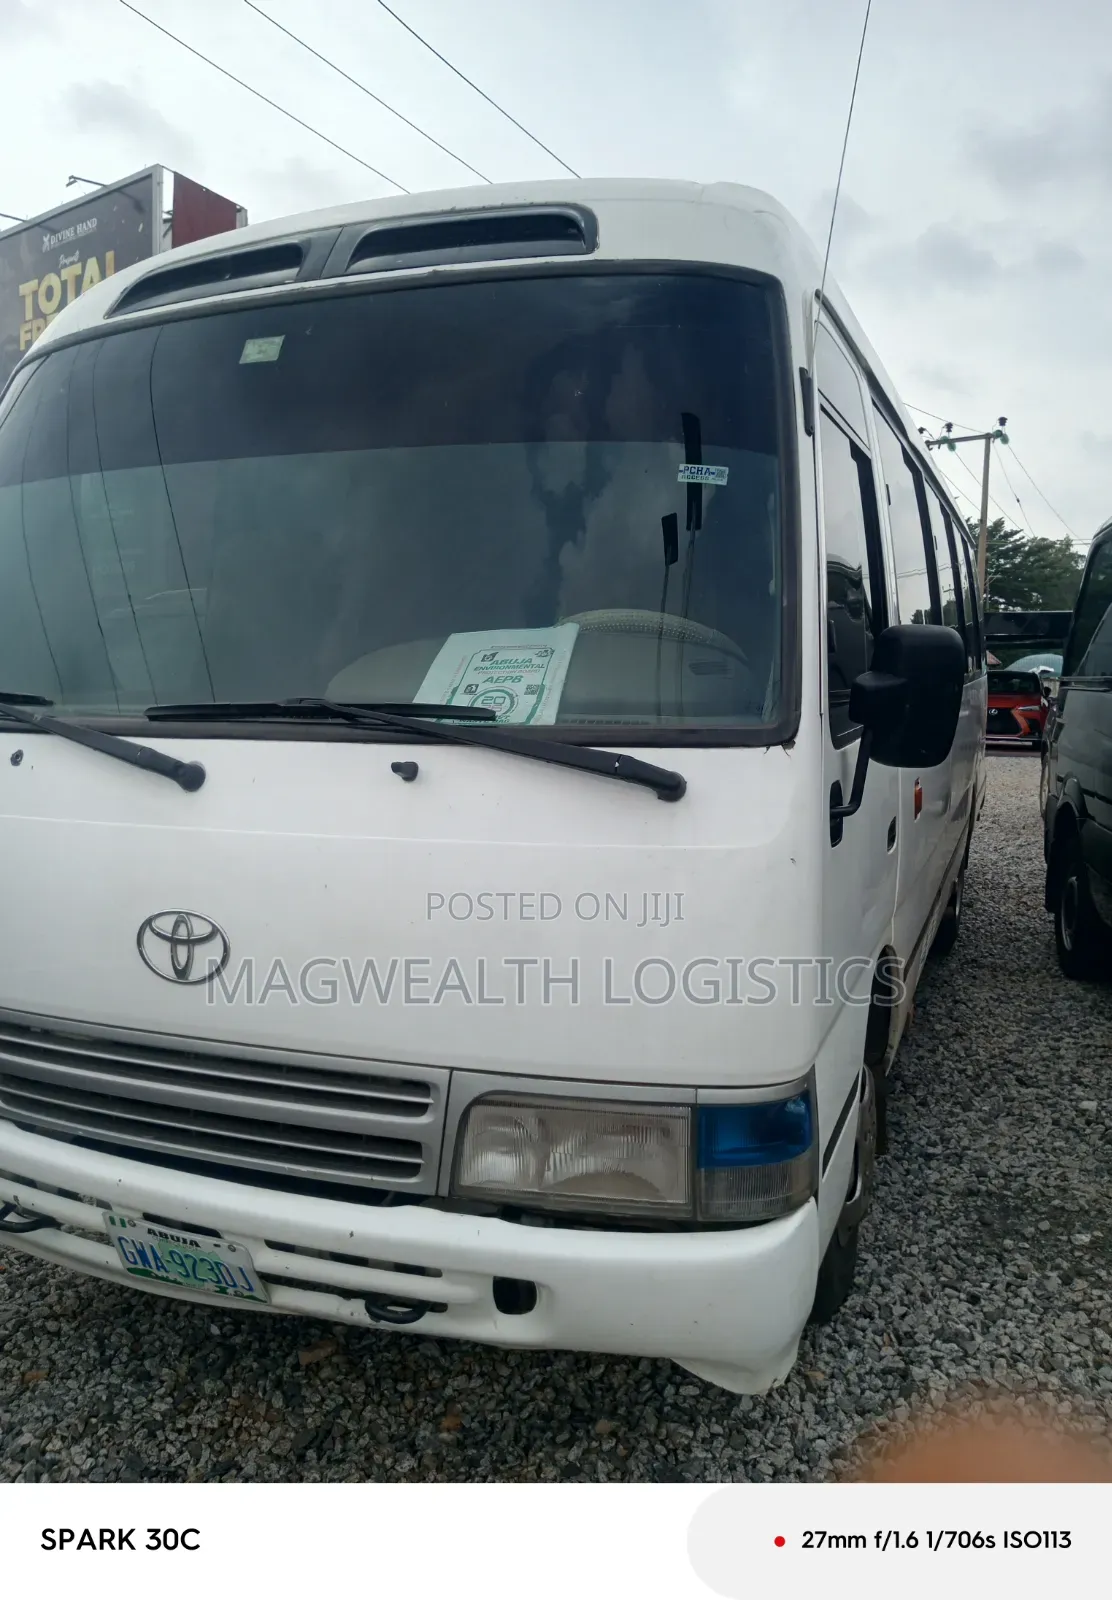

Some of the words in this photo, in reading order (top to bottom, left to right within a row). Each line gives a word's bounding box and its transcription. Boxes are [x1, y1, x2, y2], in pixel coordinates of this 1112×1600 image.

[50, 227, 75, 246] DIVINE
[77, 217, 98, 235] HAND
[490, 658, 533, 666] ABUJA
[482, 675, 524, 683] AEPB
[480, 696, 506, 705] 20
[147, 1227, 202, 1248] ABUJA
